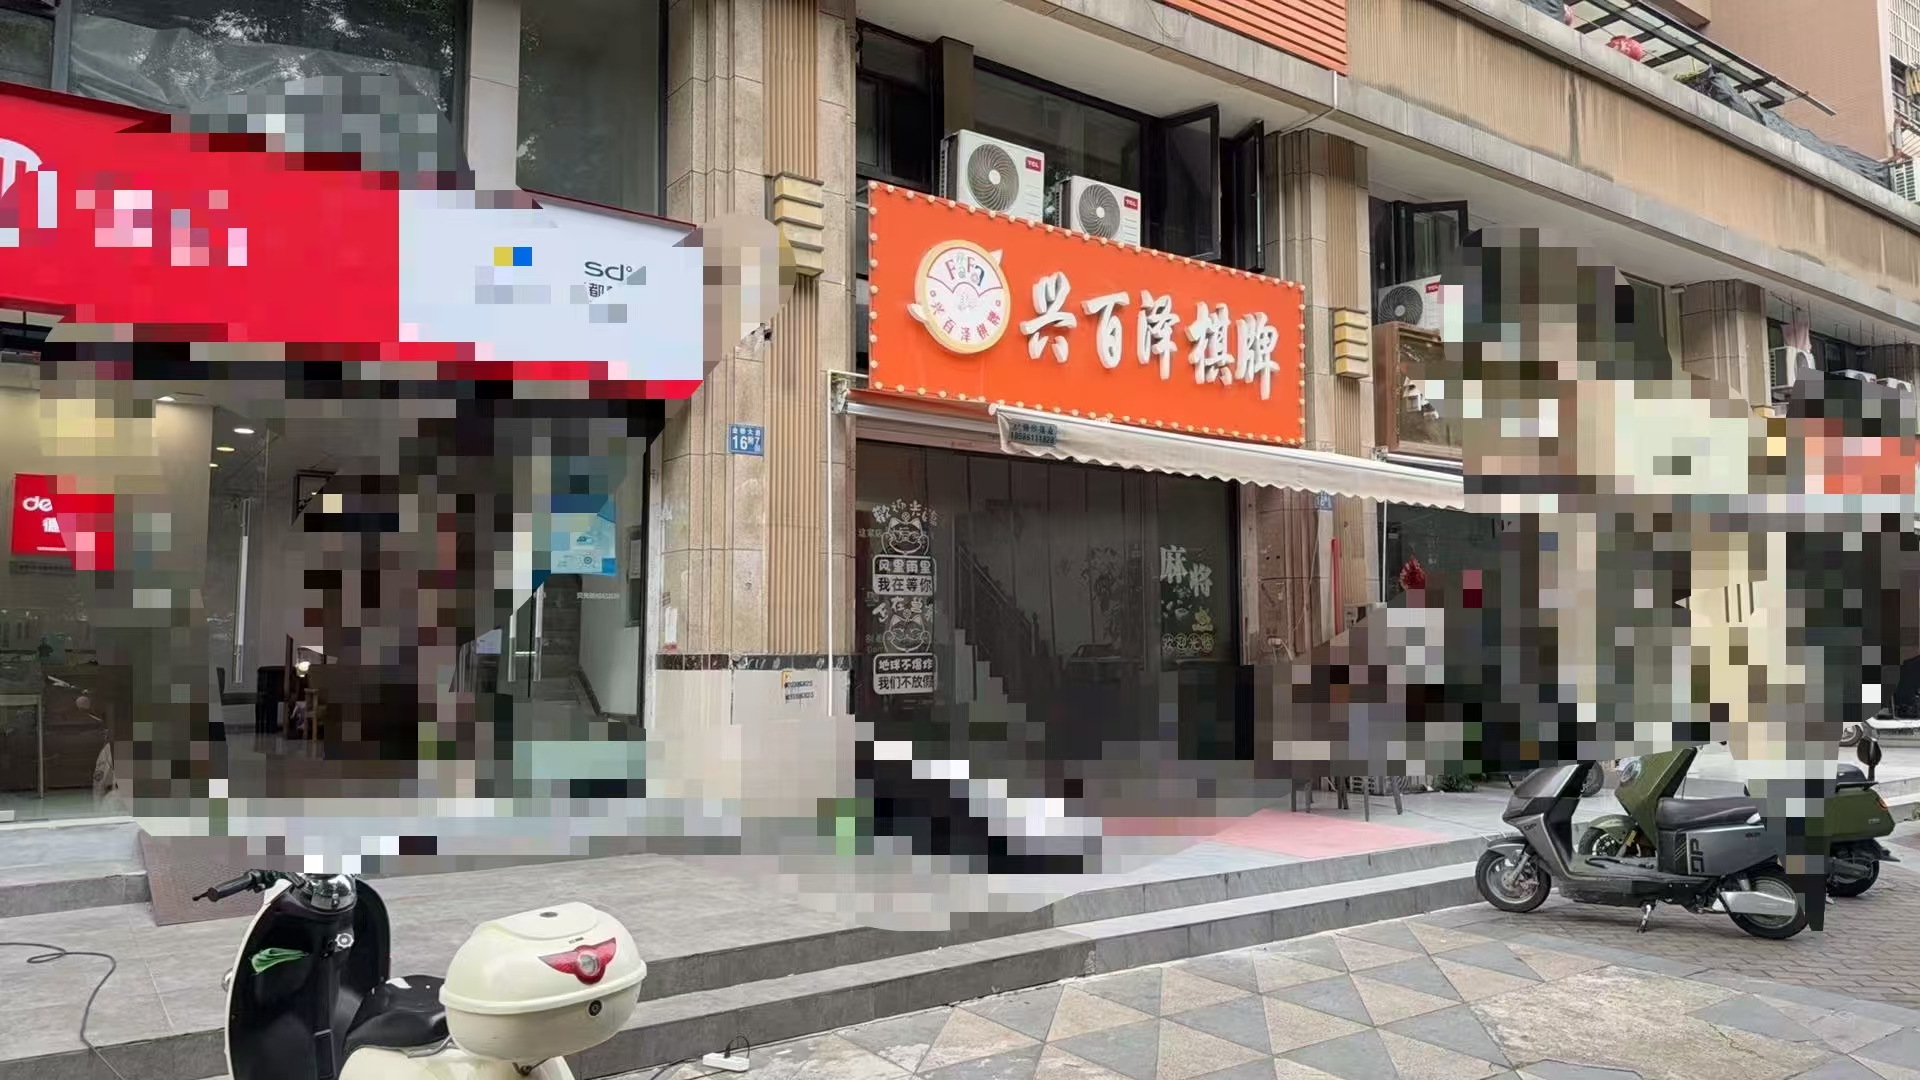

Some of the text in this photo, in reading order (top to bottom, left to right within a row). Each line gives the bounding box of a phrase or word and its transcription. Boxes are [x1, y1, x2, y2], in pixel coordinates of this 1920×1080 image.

[1027, 159, 1040, 169] TCL
[1125, 198, 1138, 207] TCL
[1019, 271, 1280, 400] 兴百泽棋牌
[879, 559, 931, 573] 风里雨里
[1160, 544, 1213, 598] 麻将
[877, 577, 933, 593] 我在等你
[878, 658, 933, 671] 地球不爆炸
[878, 675, 934, 690] 我们不放假
